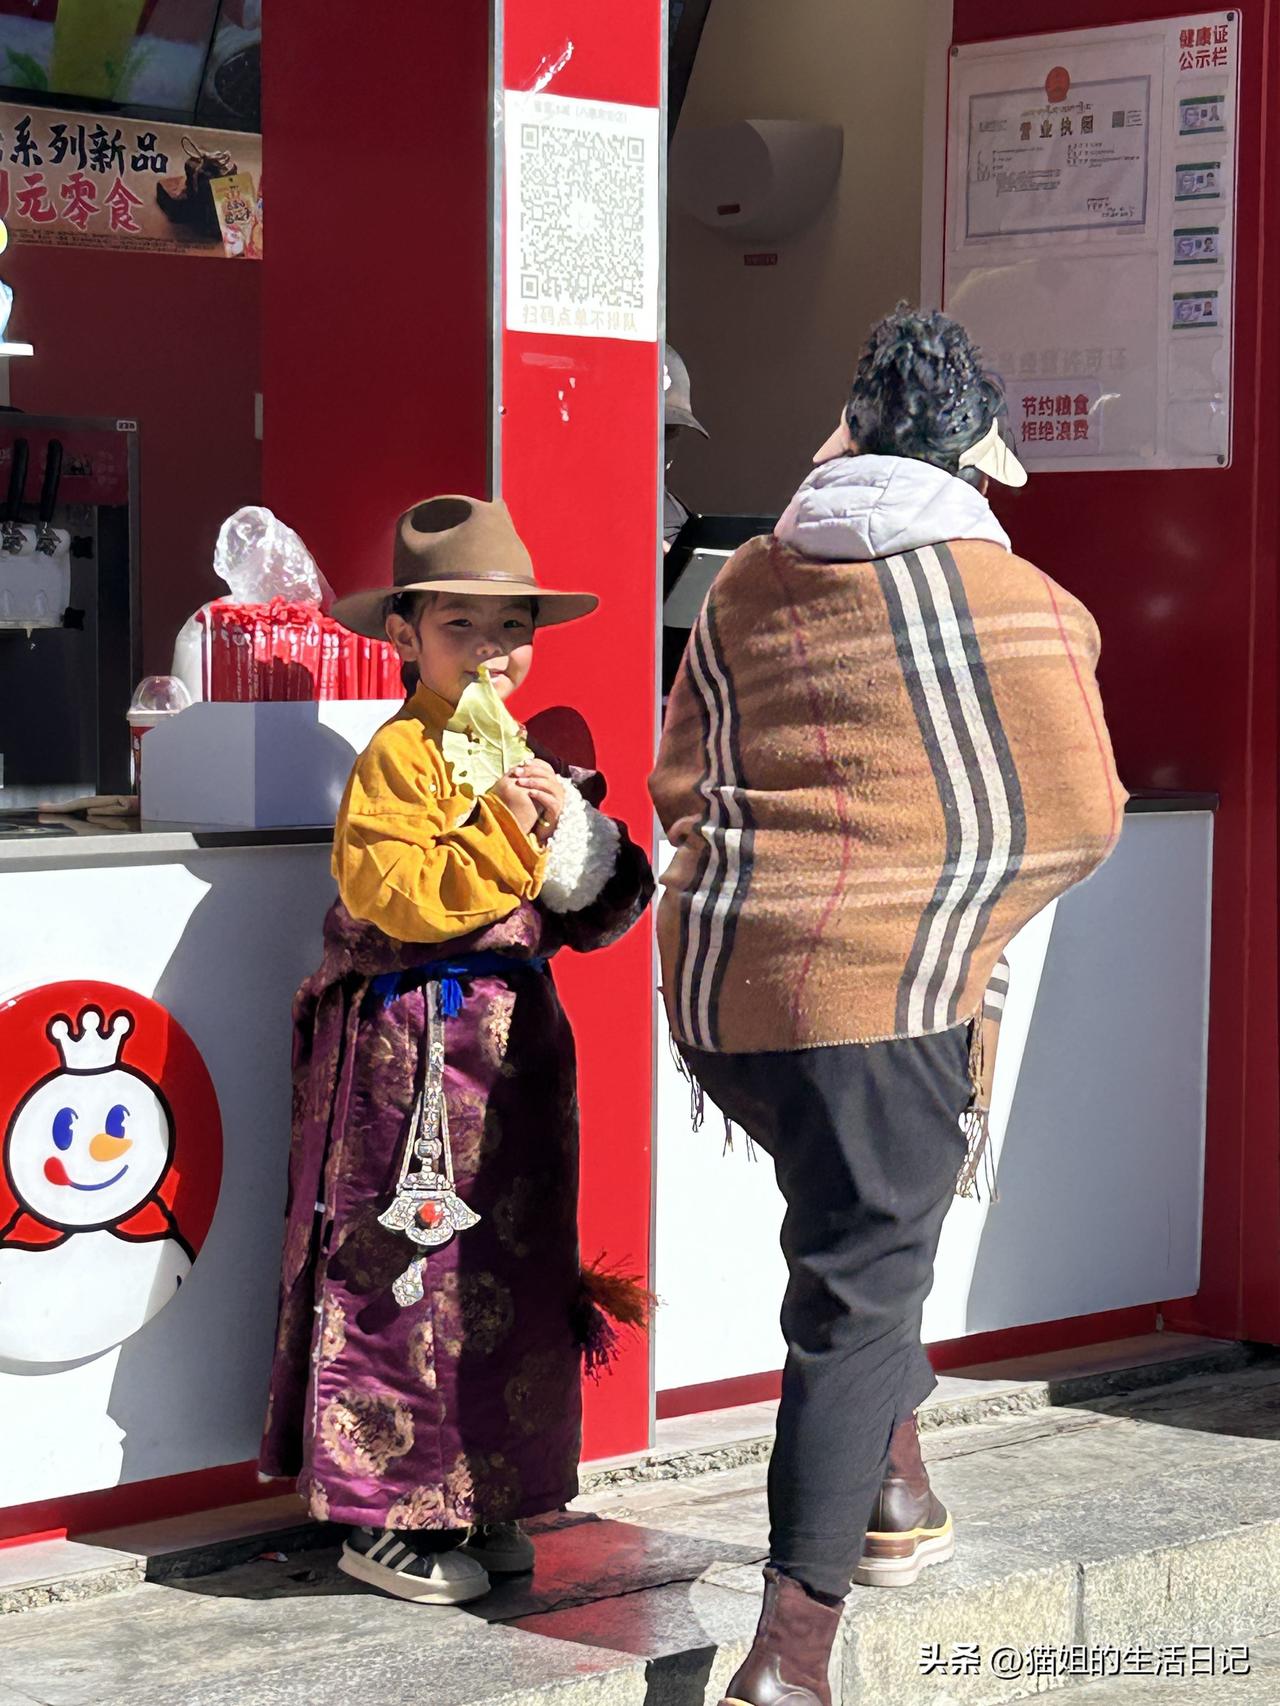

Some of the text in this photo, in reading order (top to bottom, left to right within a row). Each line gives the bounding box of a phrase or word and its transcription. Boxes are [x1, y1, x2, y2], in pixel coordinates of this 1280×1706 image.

[1180, 24, 1228, 48] 健康证
[1179, 46, 1228, 71] 公示栏
[0, 114, 169, 176] 系列新品
[523, 304, 638, 332] 扫码点单不排队
[1021, 393, 1090, 418] 节约粮食
[1021, 419, 1090, 443] 拒绝浪费
